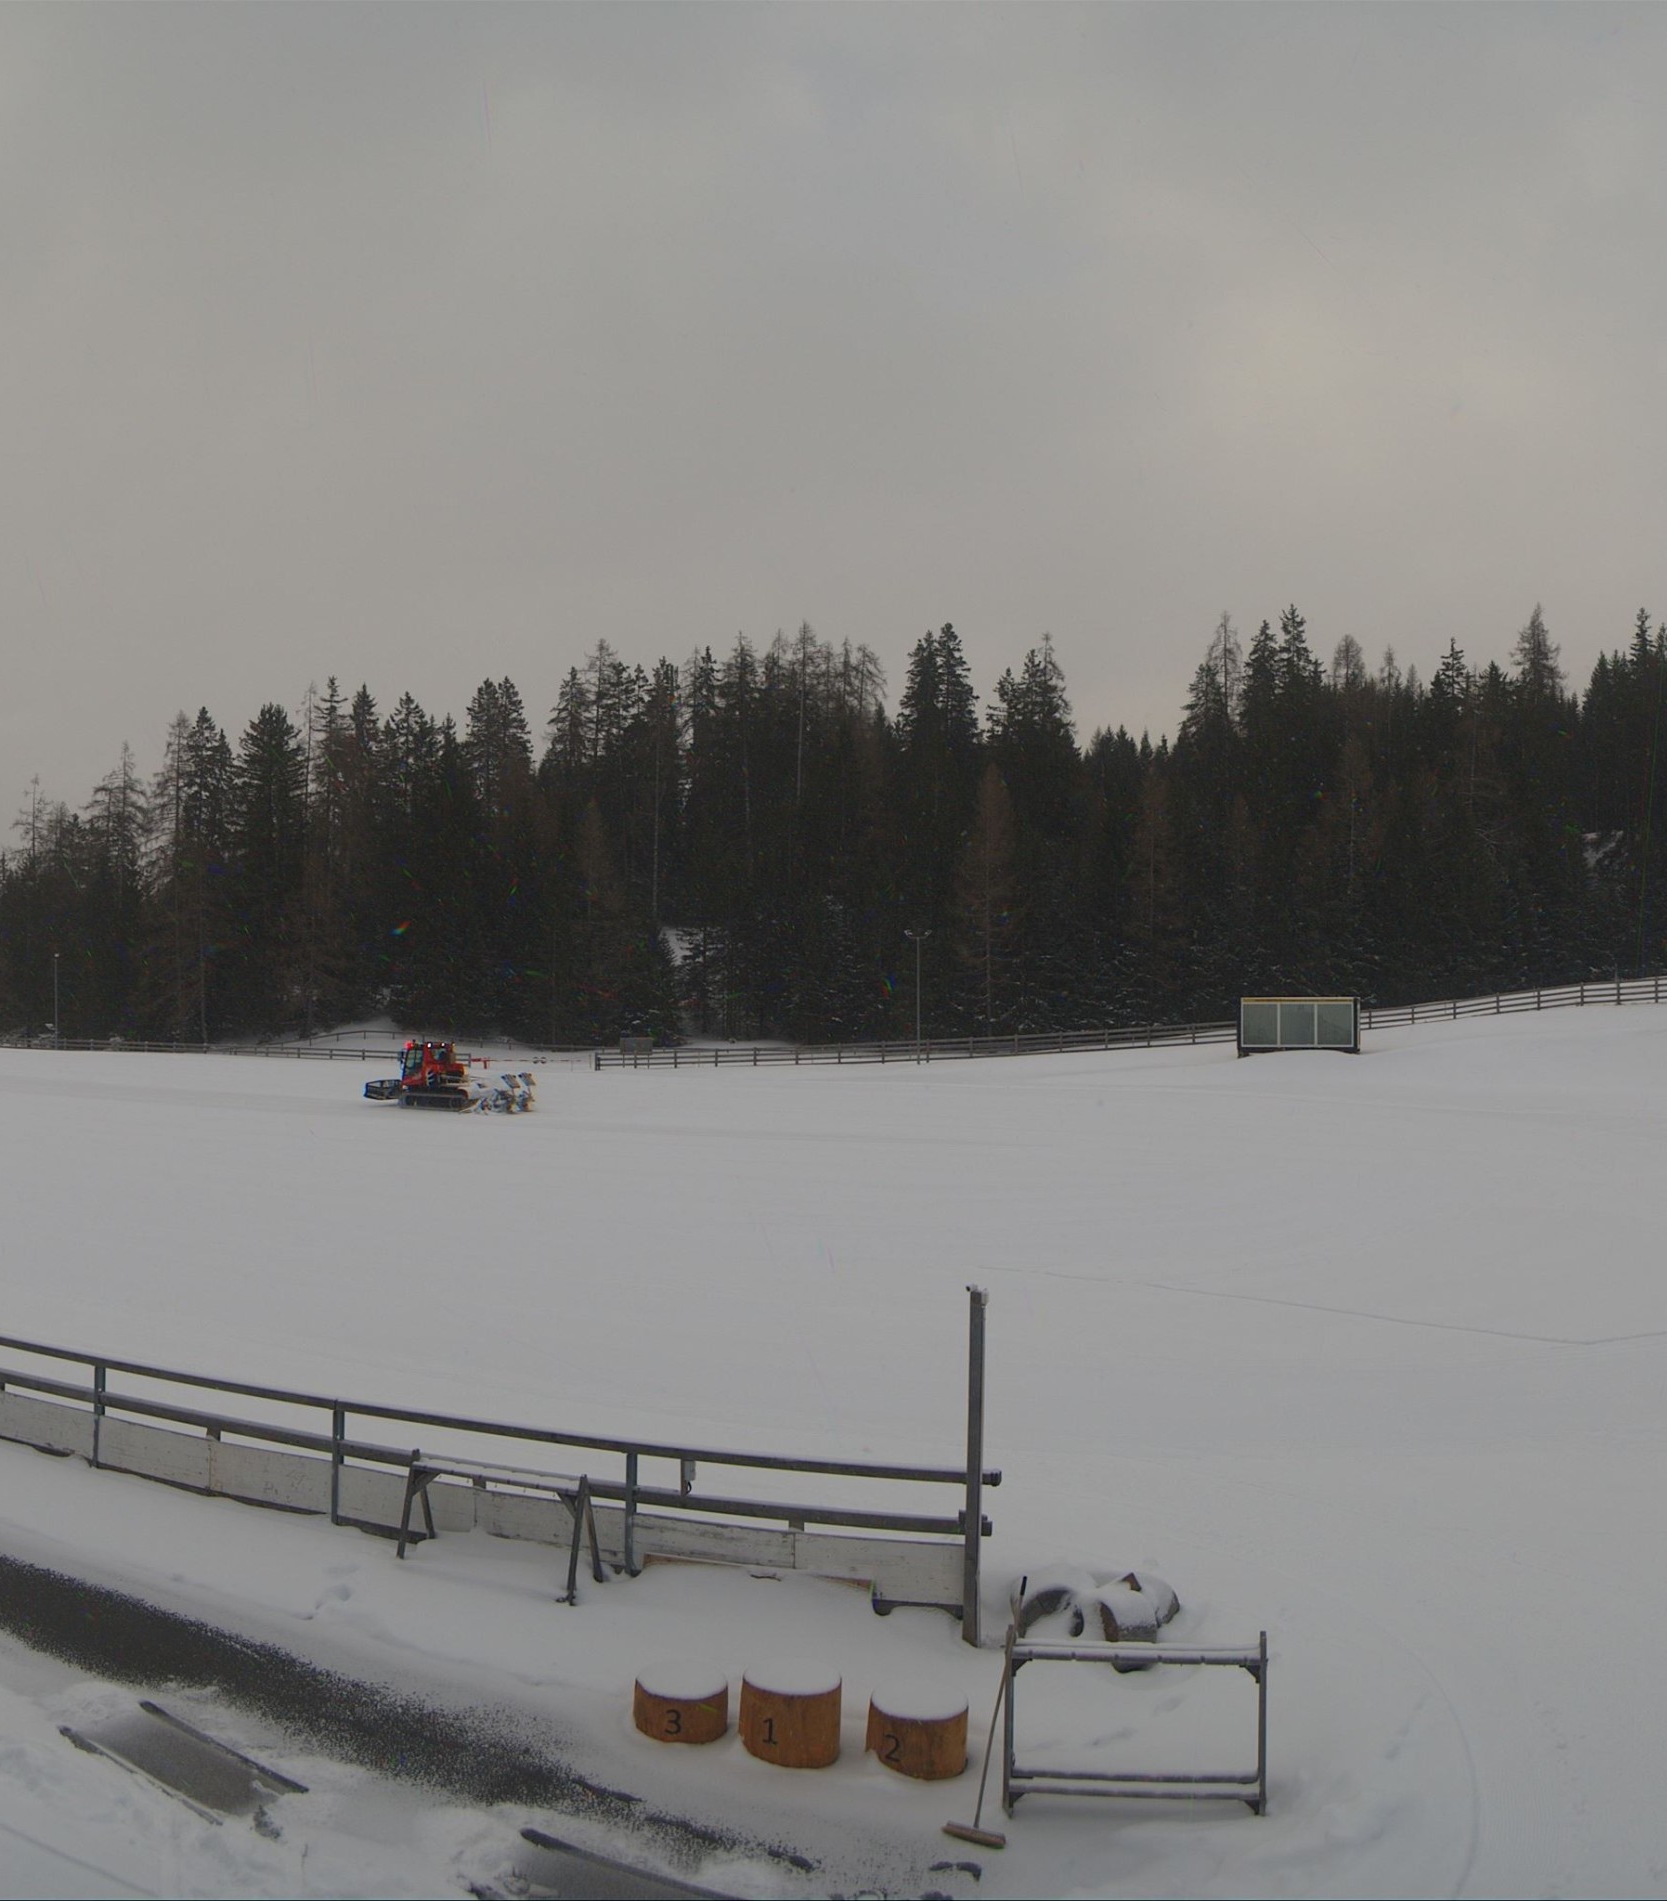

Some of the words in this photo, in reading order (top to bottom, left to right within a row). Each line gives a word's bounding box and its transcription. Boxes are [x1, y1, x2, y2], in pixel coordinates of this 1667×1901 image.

[663, 1708, 682, 1735] 3
[762, 1717, 778, 1746] 1
[883, 1733, 901, 1763] 2
